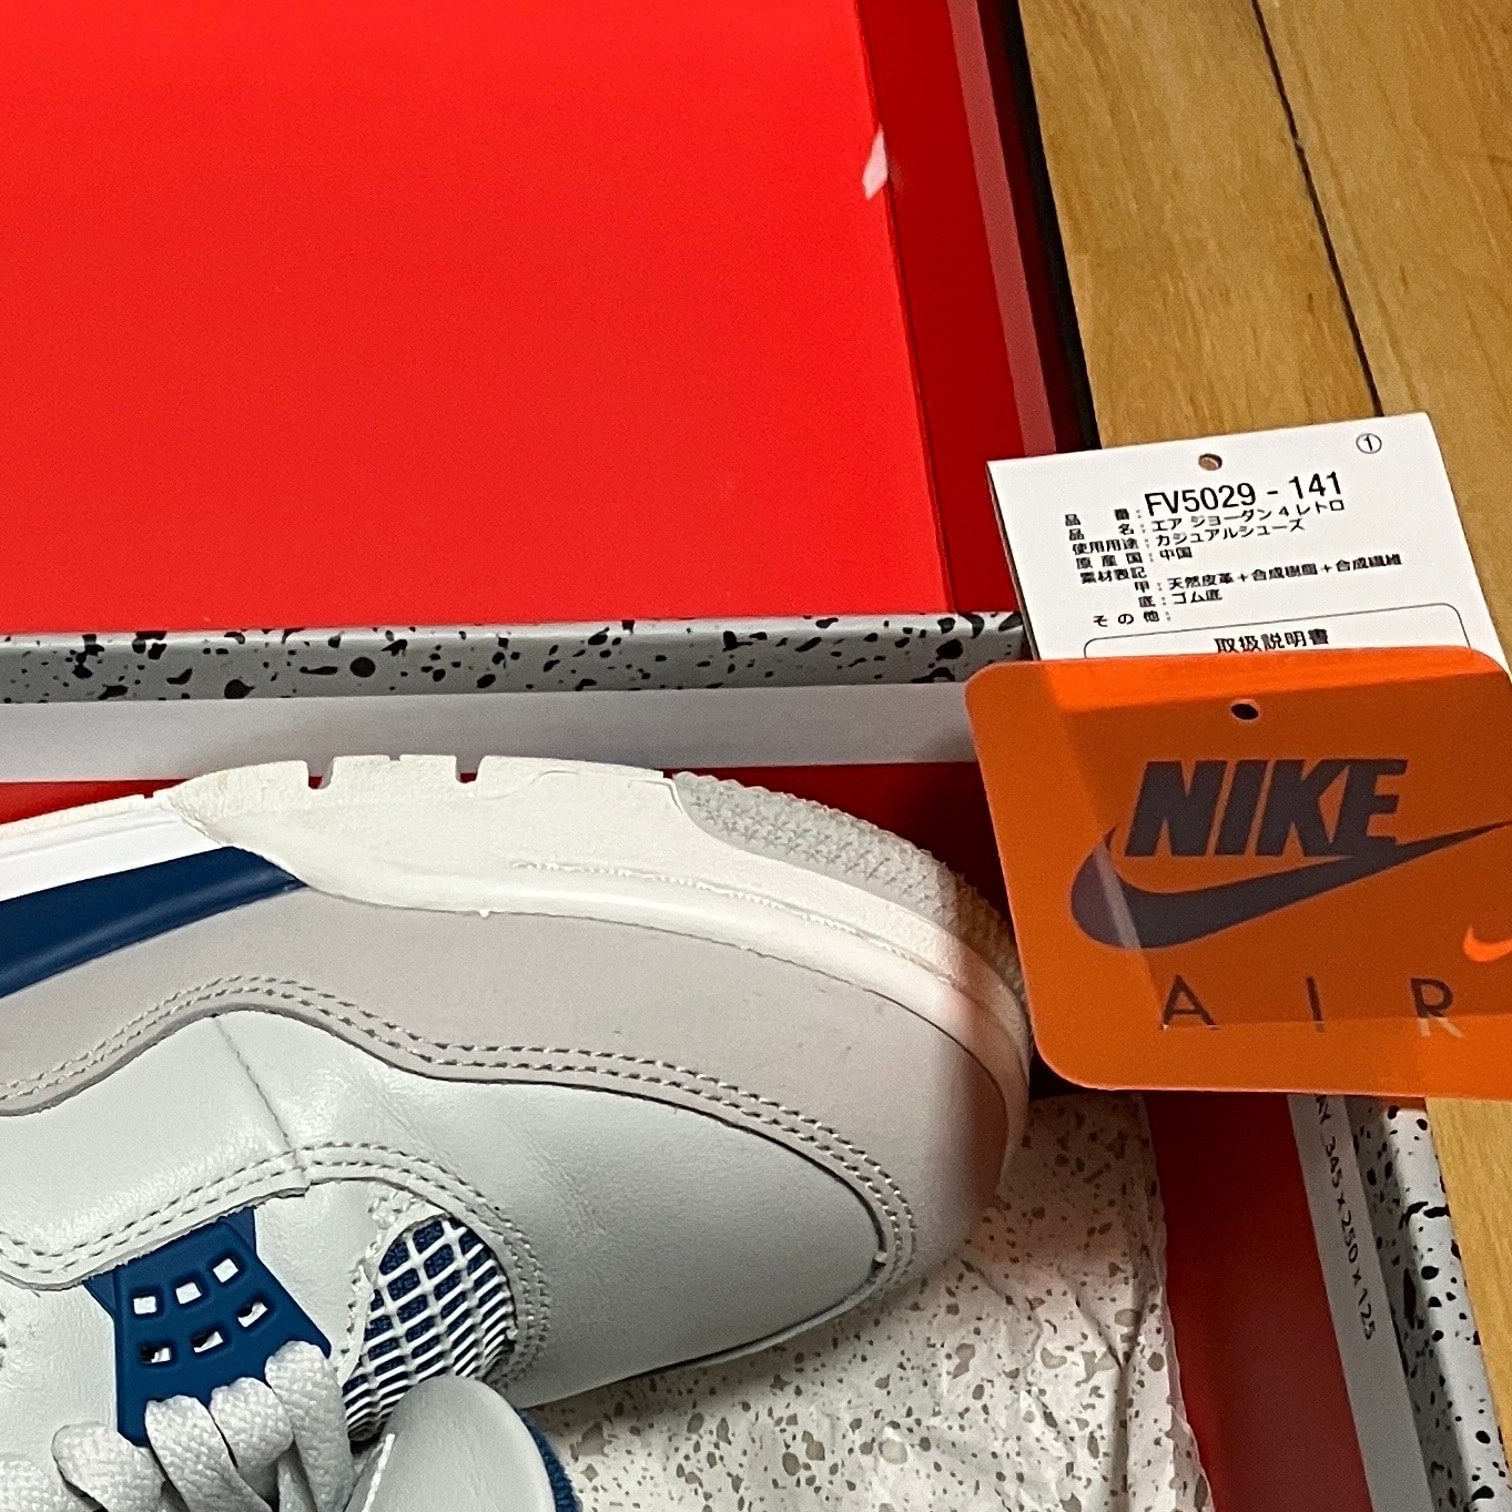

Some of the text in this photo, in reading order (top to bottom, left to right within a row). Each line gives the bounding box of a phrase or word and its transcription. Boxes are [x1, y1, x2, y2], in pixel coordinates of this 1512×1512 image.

[1144, 482, 1256, 516] FV5029
[1124, 758, 1408, 858] NIKE
[1161, 974, 1465, 1039] AIR
